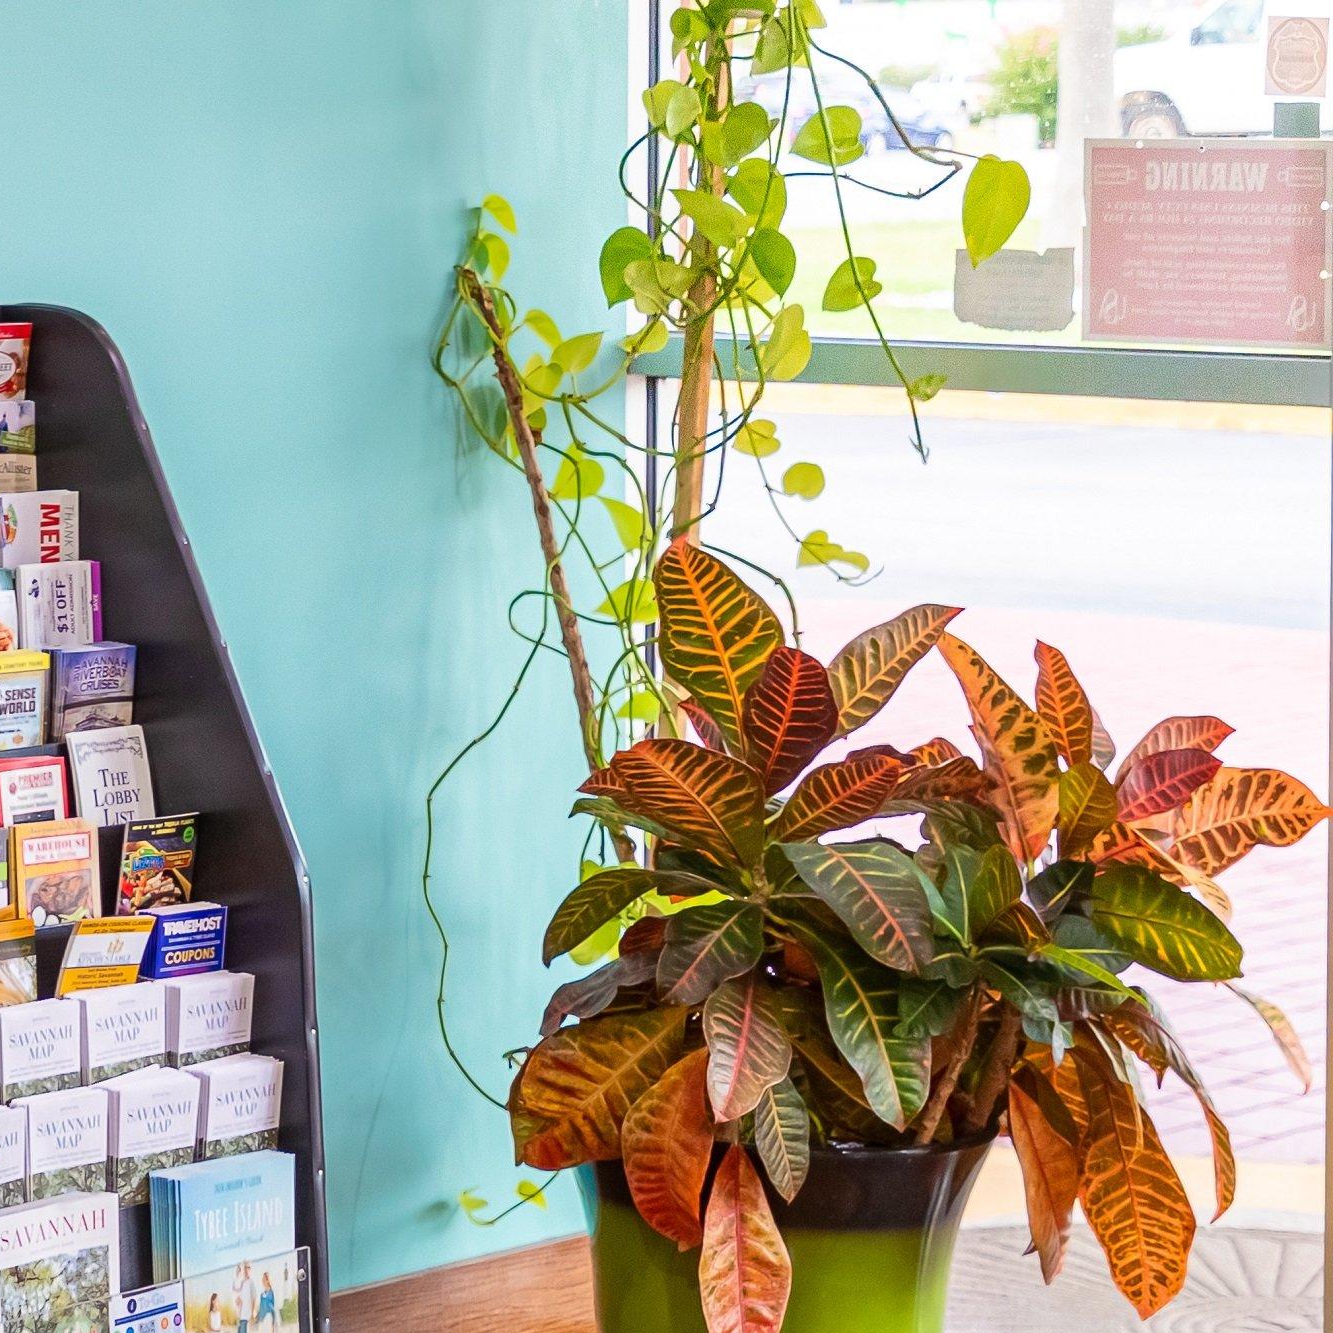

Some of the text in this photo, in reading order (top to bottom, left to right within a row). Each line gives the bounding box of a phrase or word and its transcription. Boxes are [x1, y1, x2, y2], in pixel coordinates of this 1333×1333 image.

[62, 505, 75, 562] THANK Y
[55, 579, 70, 634] $1 OFF
[72, 666, 128, 682] RIVERBOAT
[73, 657, 129, 673] SAVANNAH
[79, 678, 120, 692] CRUISES
[98, 767, 130, 789] THE
[93, 787, 141, 808] LOBBY
[103, 808, 136, 828] LIST
[27, 836, 88, 853] WAREHOUSE
[109, 919, 132, 928] COOKING
[131, 918, 153, 927] CLASSES
[162, 916, 223, 938] TRAVELHOST
[164, 946, 216, 967] COUPONS
[94, 1007, 159, 1032] SAVANNAH
[186, 997, 248, 1022] SAVANNAH
[205, 1016, 229, 1032] MAP
[8, 1025, 74, 1049] SAVANNAH
[113, 1027, 141, 1046] MAP
[28, 1044, 55, 1062] MAP
[215, 1083, 277, 1108] SAVANNAH
[125, 1101, 192, 1125] SAVANNAH
[233, 1102, 257, 1118] MAP
[35, 1114, 102, 1138] SAVANNAH
[145, 1119, 172, 1137] MAP
[54, 1133, 82, 1151] MAP
[194, 1196, 284, 1243] TYBEE ISLAND
[0, 1208, 107, 1253] SAVANNAH
